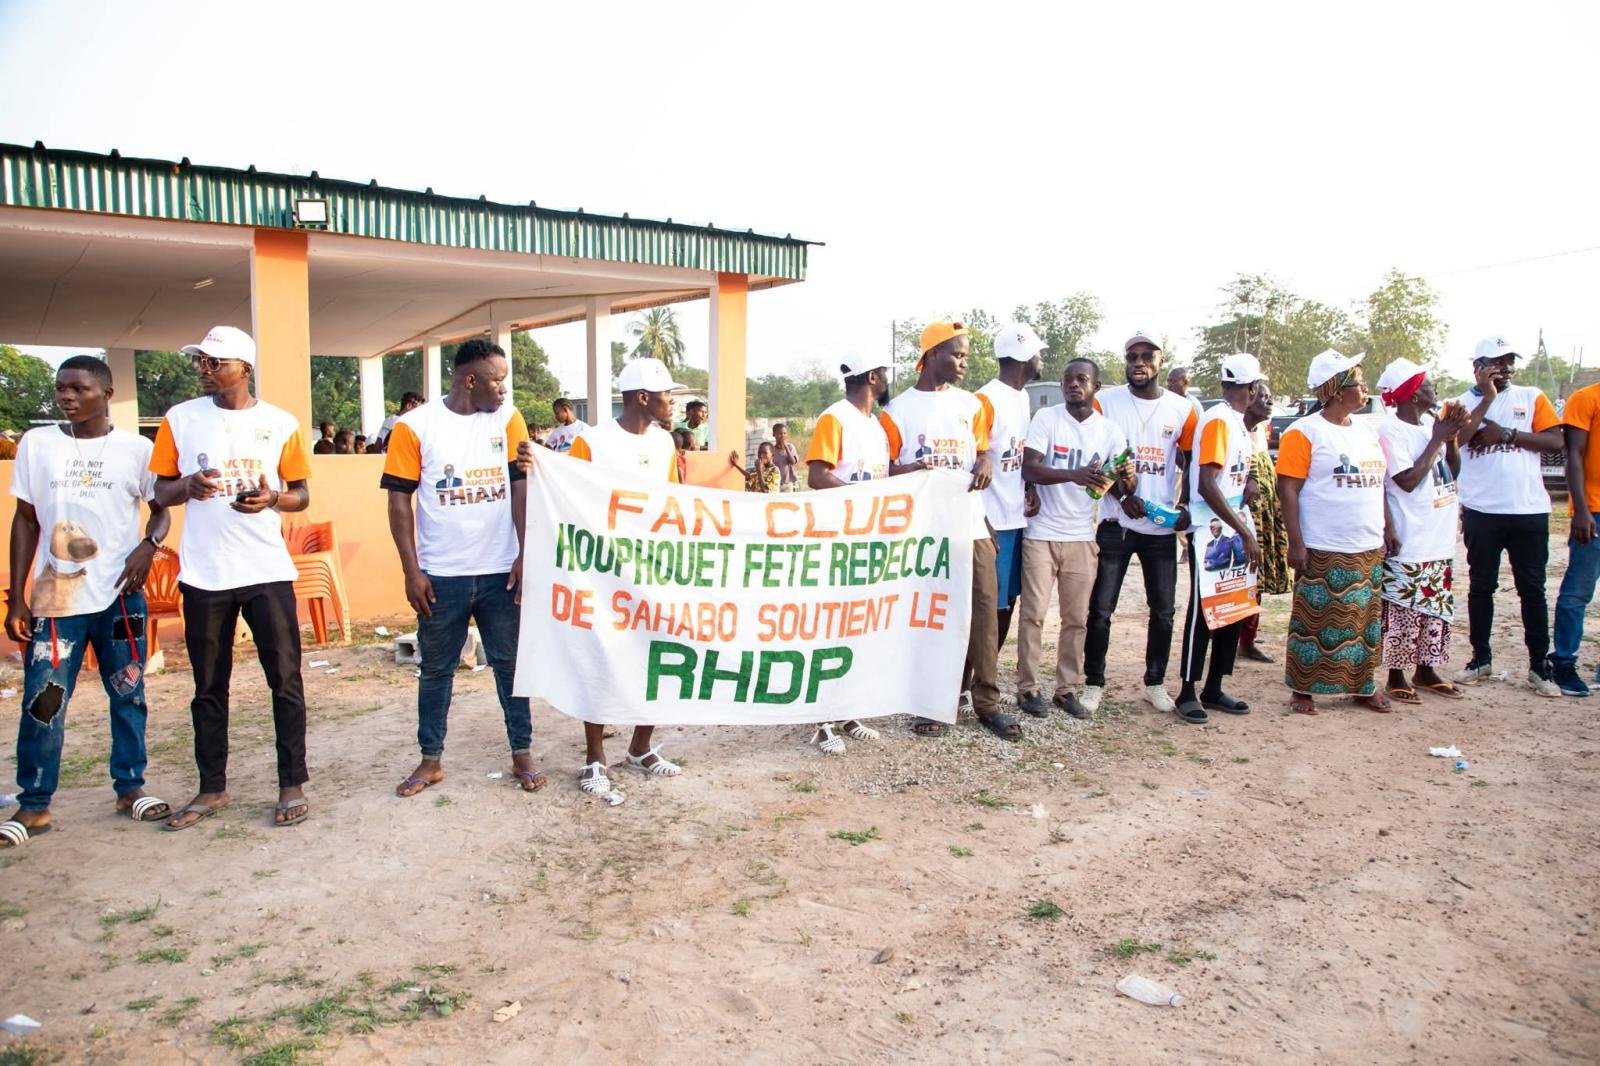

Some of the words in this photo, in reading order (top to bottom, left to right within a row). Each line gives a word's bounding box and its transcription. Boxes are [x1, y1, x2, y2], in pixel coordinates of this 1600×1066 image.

[87, 460, 104, 468] NOT
[87, 470, 103, 478] THE
[465, 467, 504, 479] VOTEZ
[436, 484, 506, 505] THIAM
[607, 489, 732, 537] FAN
[765, 493, 914, 538] CLUB
[556, 522, 735, 588] HOUPHOUET
[743, 542, 820, 588] FETE
[829, 536, 950, 586] REBECCA
[552, 584, 594, 630] DE
[613, 590, 738, 642] SAHABO
[758, 594, 899, 642] SOUTIENT
[909, 591, 948, 630] LE
[646, 640, 853, 704] RHDP
